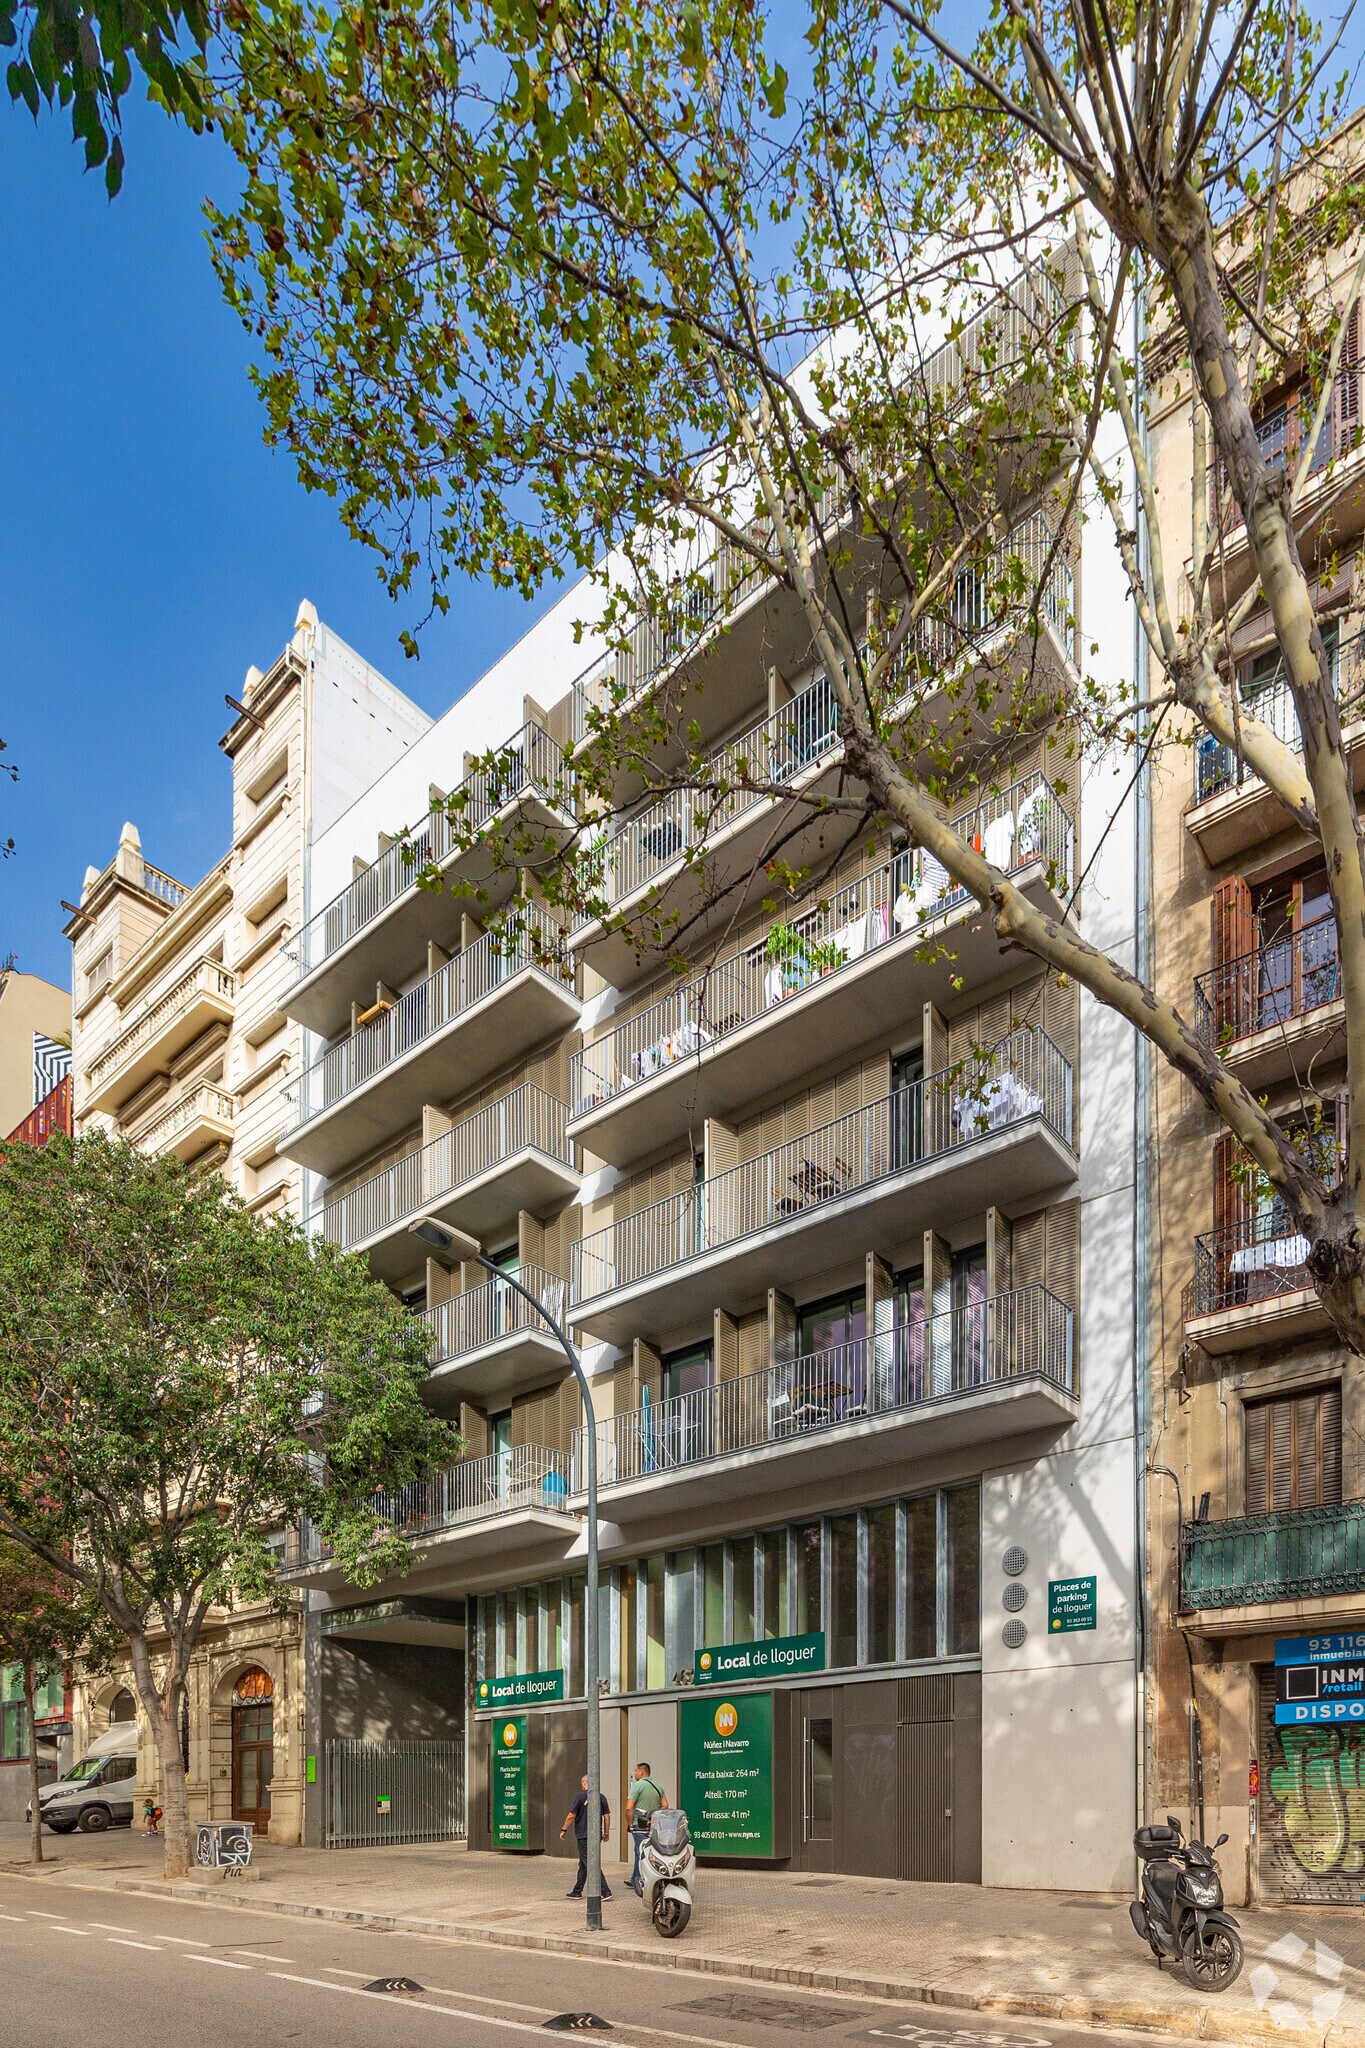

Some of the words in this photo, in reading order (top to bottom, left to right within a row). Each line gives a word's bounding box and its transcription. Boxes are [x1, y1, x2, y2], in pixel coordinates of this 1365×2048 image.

[1054, 1583, 1079, 1592] Places
[1080, 1581, 1092, 1589] de
[1057, 1593, 1087, 1604] parking
[1064, 1604, 1092, 1613] lloguer
[1309, 1638, 1331, 1651] 93
[718, 1652, 750, 1670] Local
[753, 1651, 768, 1665] de
[771, 1647, 816, 1665] lloguer
[492, 1683, 514, 1697] Local
[516, 1682, 525, 1694] de
[527, 1680, 557, 1694] lloguer
[704, 1740, 722, 1749] Núñez
[695, 1771, 715, 1779] Planta
[716, 1770, 734, 1778] baixa:
